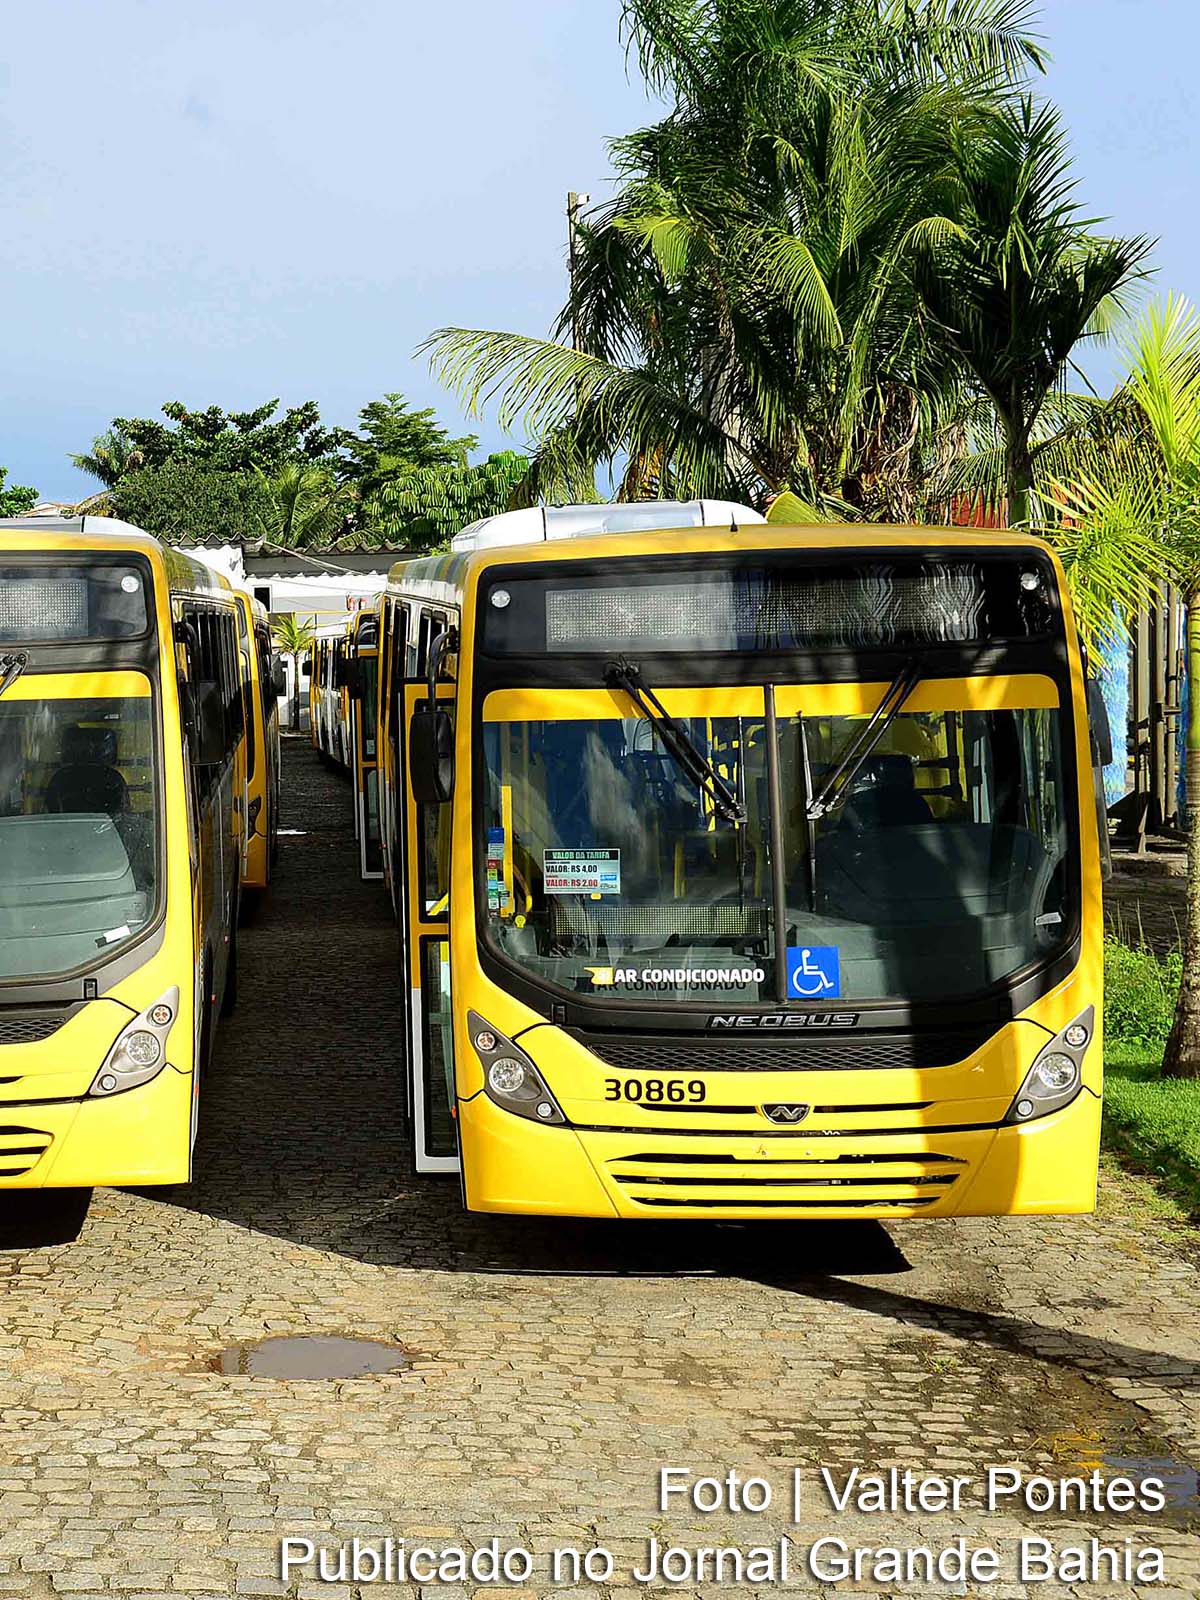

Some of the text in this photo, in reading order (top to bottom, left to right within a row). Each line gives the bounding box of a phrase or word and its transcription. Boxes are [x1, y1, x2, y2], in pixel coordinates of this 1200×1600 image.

[552, 851, 610, 859] VALOR DA TARIFA
[545, 865, 570, 873] VALOR:
[546, 879, 570, 887] VALOR:
[614, 968, 765, 983] AR CONDICIONADO
[711, 1014, 856, 1027] NEOBUS
[604, 1078, 706, 1103] 30869
